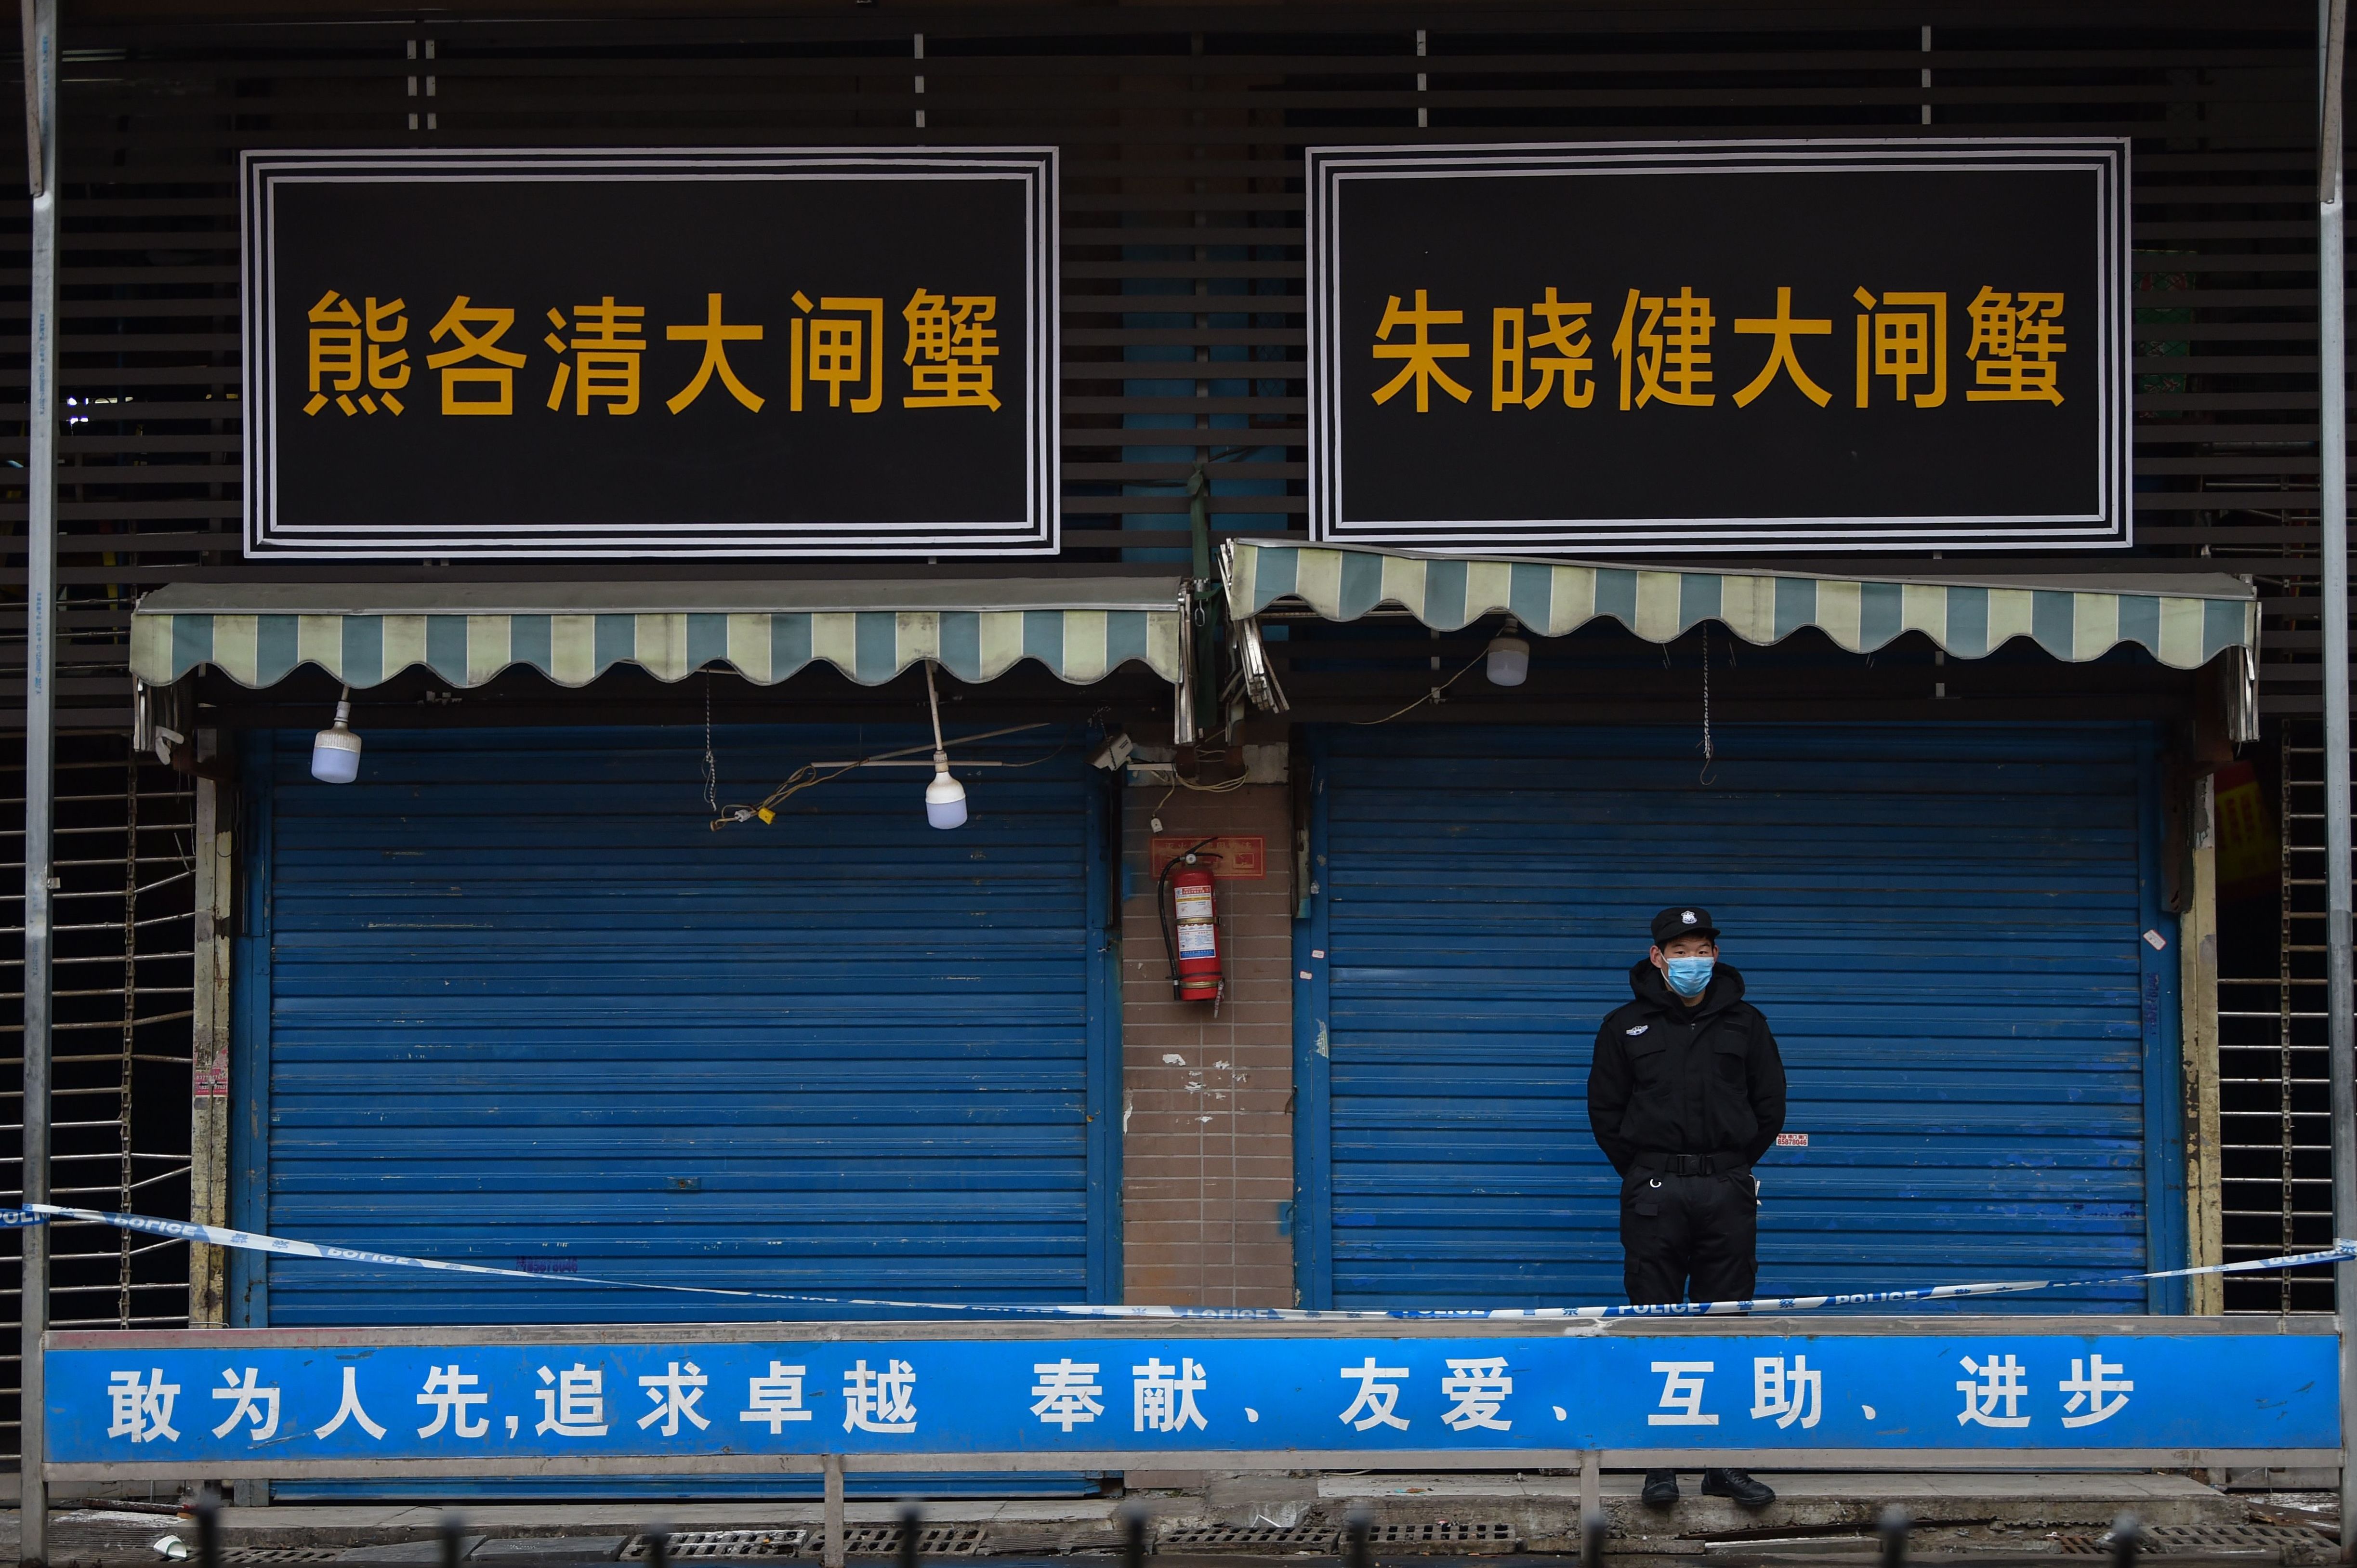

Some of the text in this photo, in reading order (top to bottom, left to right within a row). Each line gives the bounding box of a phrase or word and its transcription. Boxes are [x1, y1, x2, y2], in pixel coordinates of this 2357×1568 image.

[303, 288, 1001, 416] 熊各清大闸蟹
[1372, 286, 2067, 412] 朱晓健大闸蟹
[1619, 1303, 1701, 1314] POLICE
[1836, 1291, 1918, 1304] POLICE
